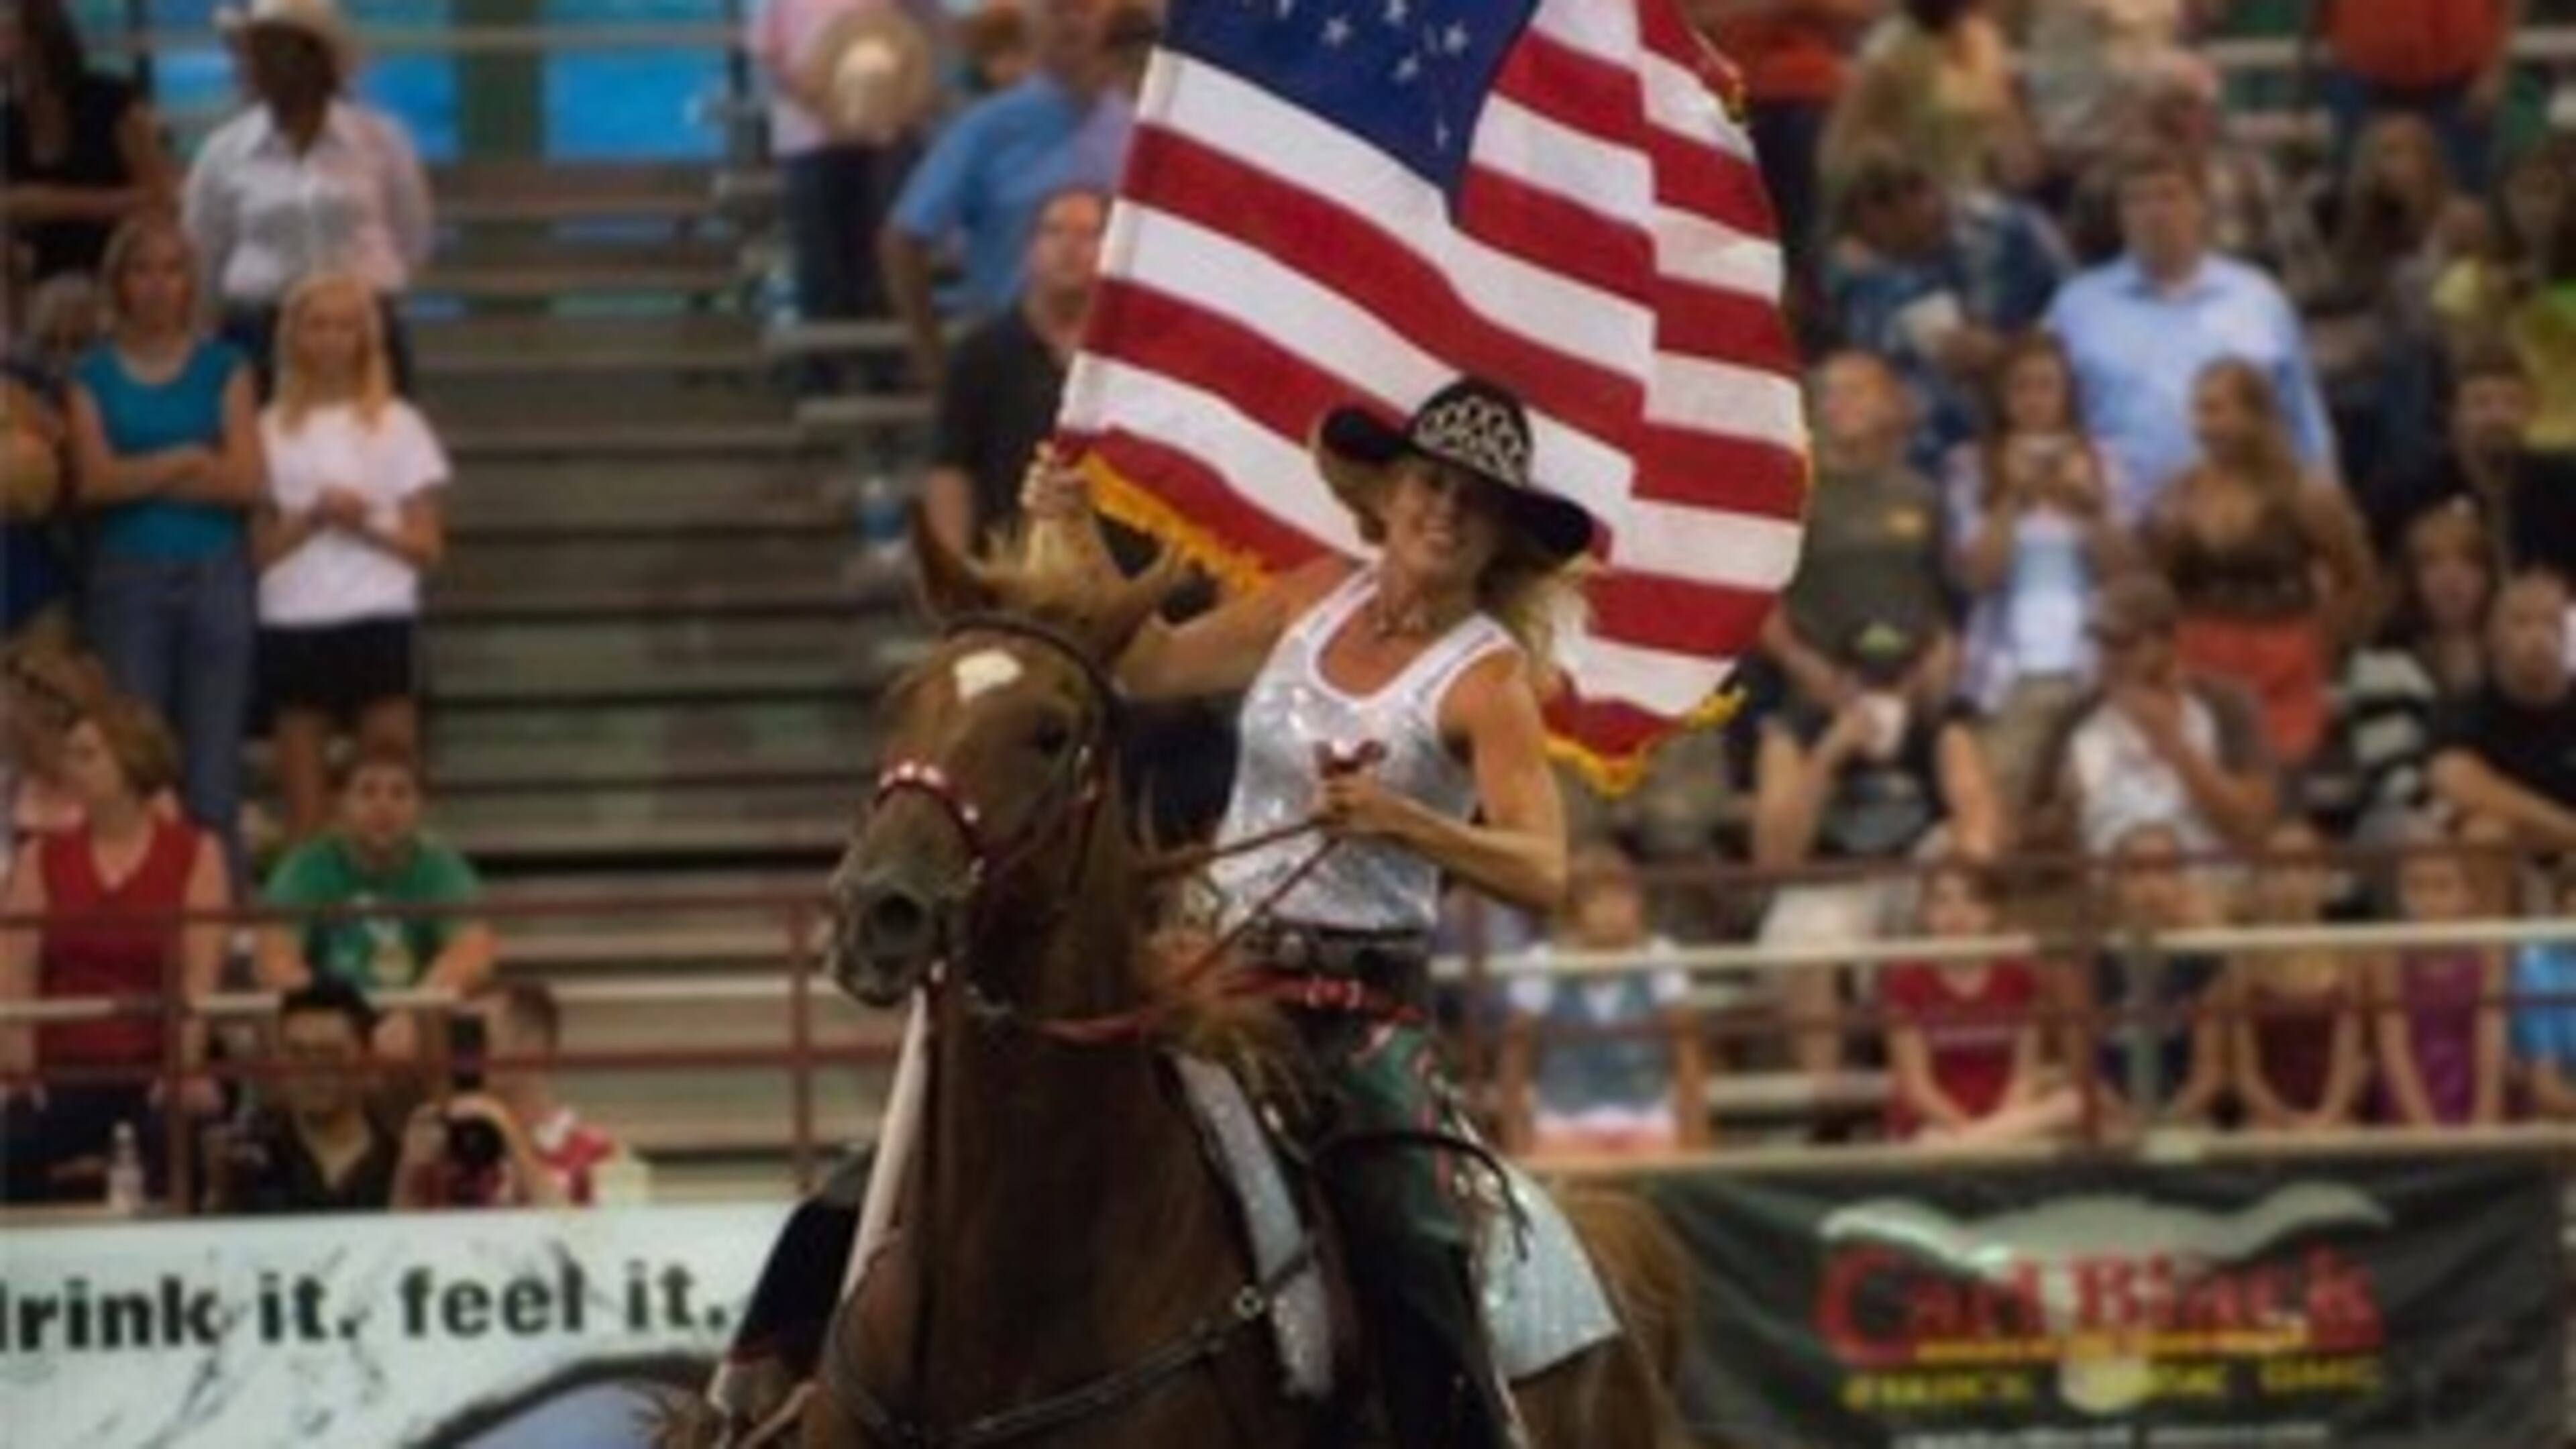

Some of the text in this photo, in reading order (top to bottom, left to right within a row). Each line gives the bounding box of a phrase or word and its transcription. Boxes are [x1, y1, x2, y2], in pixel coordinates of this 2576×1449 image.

[259, 1272, 360, 1342] it.
[402, 1260, 584, 1337] feel
[627, 1260, 727, 1330] it.
